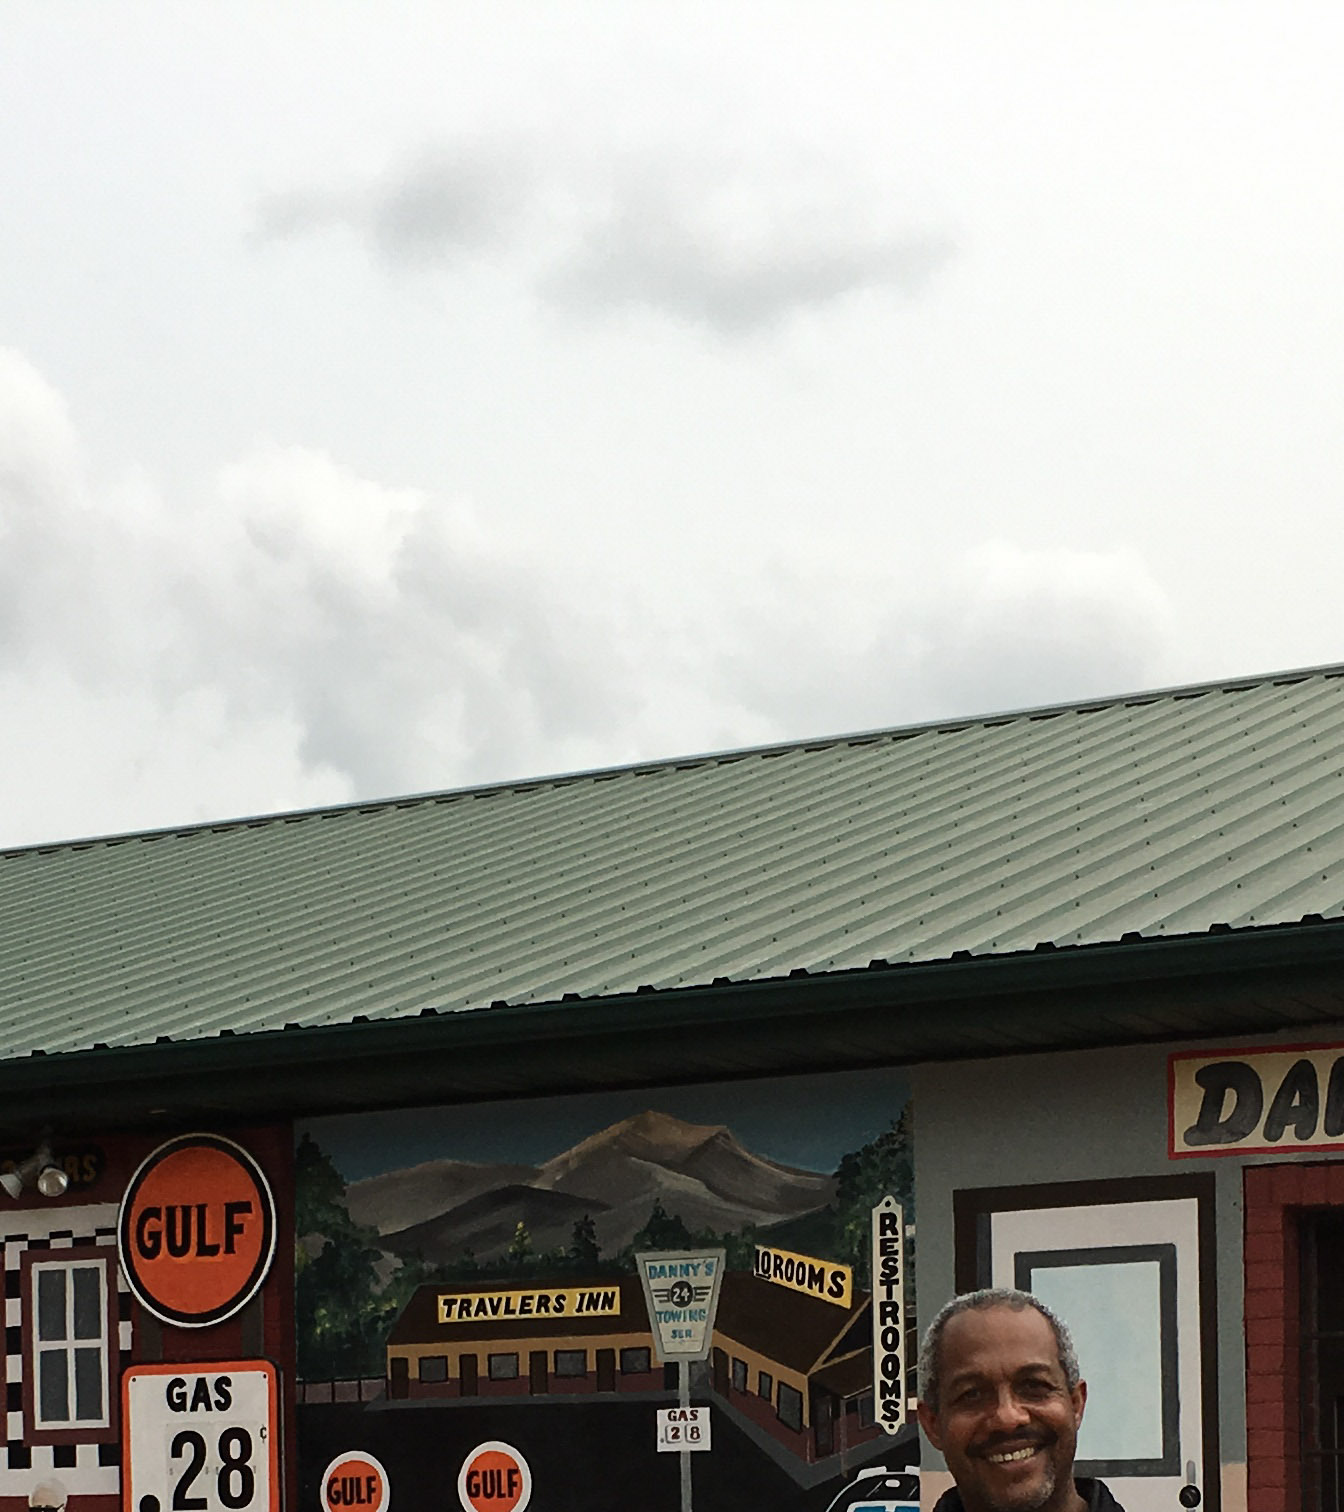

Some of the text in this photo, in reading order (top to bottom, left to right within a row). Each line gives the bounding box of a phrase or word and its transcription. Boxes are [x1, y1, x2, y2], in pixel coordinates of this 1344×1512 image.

[136, 1201, 253, 1260] GULF
[648, 1259, 714, 1279] DANNY'S
[442, 1290, 616, 1319] TRAVLERS INN
[673, 1287, 690, 1302] 24
[655, 1309, 706, 1324] TOWING
[880, 1212, 901, 1423] RESTROOMS
[166, 1376, 233, 1412] GAS
[667, 1409, 699, 1422] GAS
[327, 1475, 377, 1506] GULF
[466, 1468, 519, 1499] GULF
